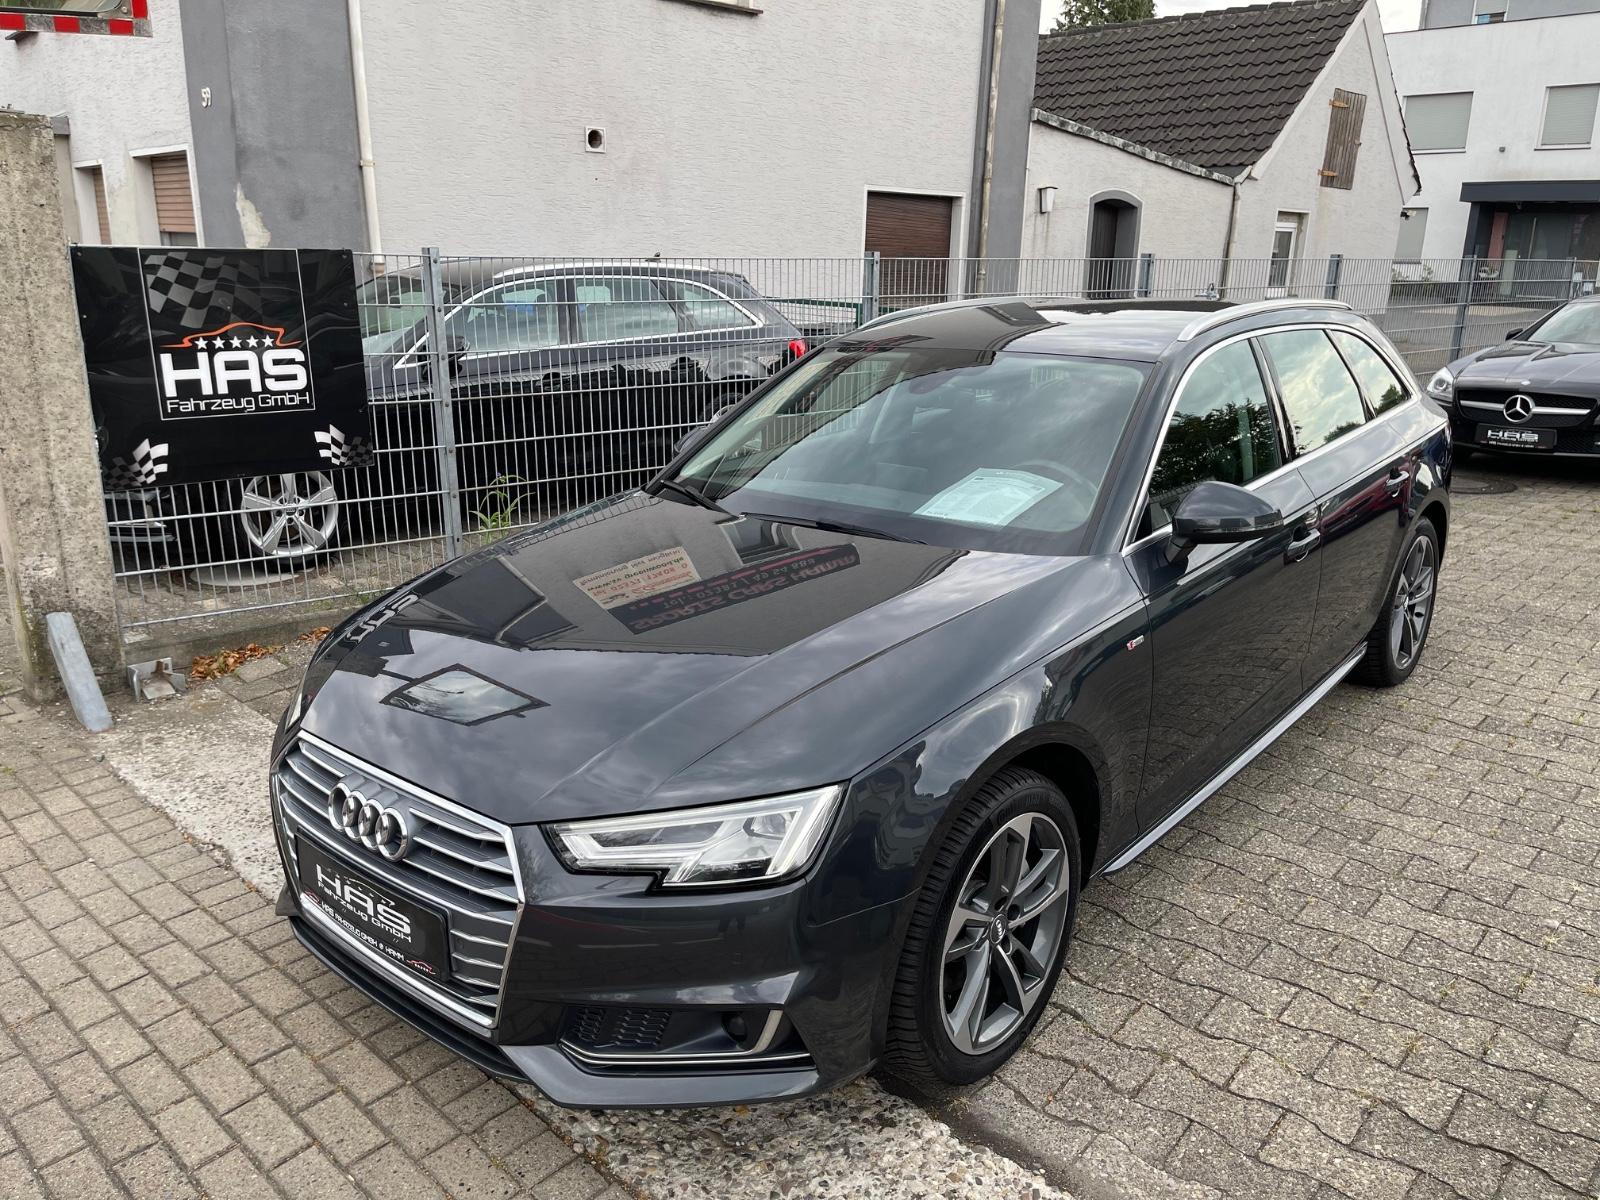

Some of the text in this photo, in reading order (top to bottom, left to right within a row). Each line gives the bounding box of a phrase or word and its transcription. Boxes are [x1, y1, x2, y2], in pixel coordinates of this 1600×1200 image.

[201, 86, 211, 107] 59
[160, 348, 308, 398] HAS
[166, 391, 310, 413] Fahrzeug GmbH
[315, 863, 412, 935] HAS
[317, 880, 412, 943] Fahrzeug GmbH
